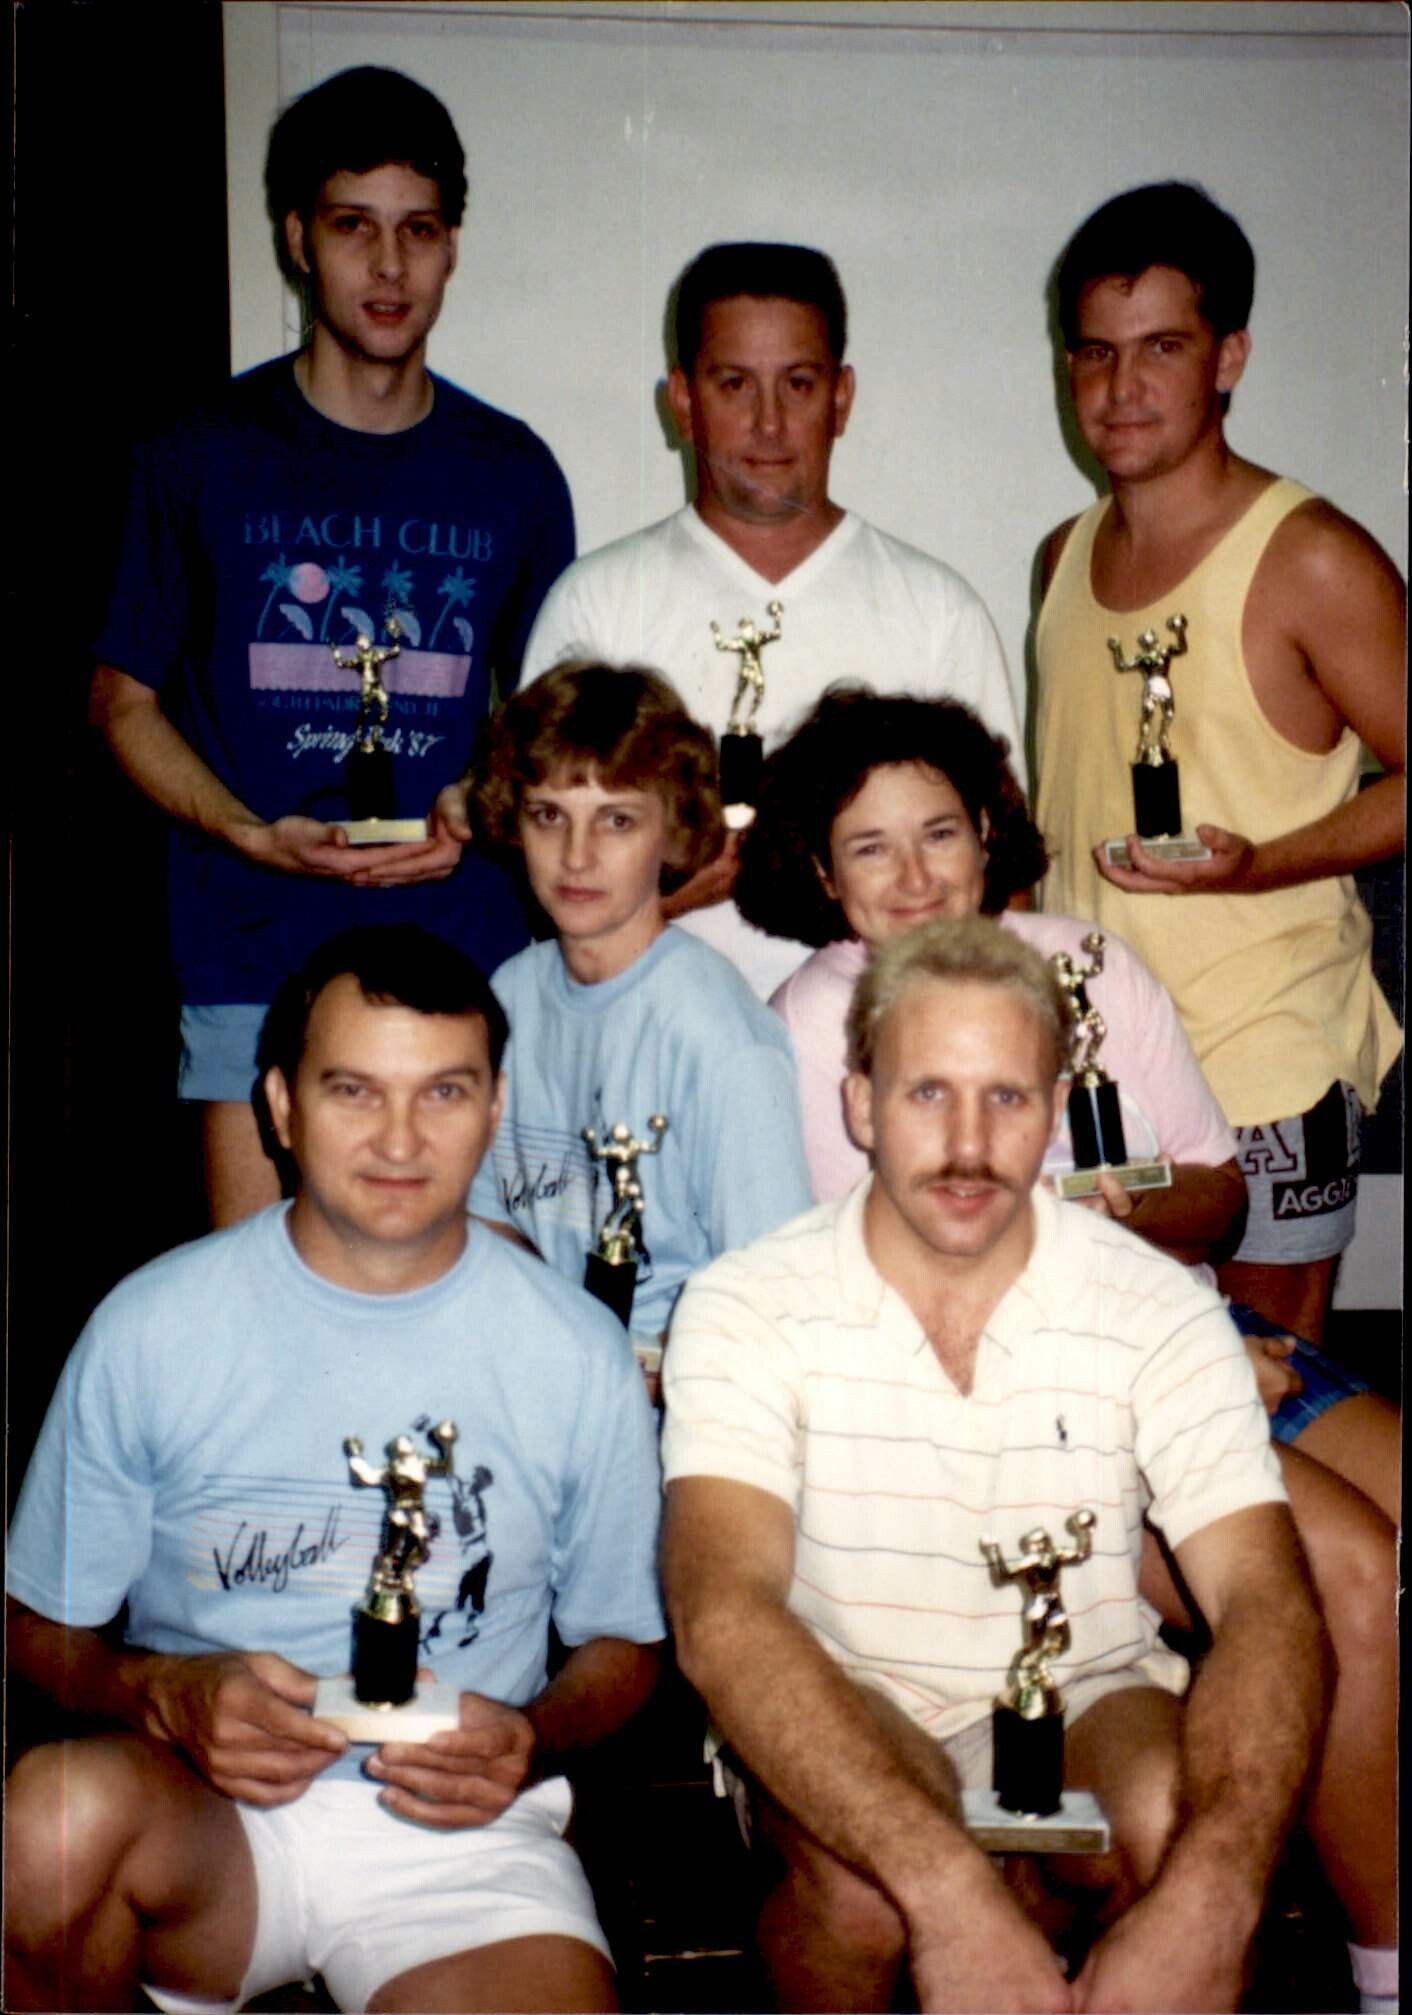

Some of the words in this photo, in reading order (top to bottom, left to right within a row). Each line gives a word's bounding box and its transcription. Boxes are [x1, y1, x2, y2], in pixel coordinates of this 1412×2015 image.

[243, 514, 382, 548] BEACH
[398, 519, 494, 562] CLUB
[286, 722, 356, 764] Spring
[212, 1503, 350, 1593] Volleyball
